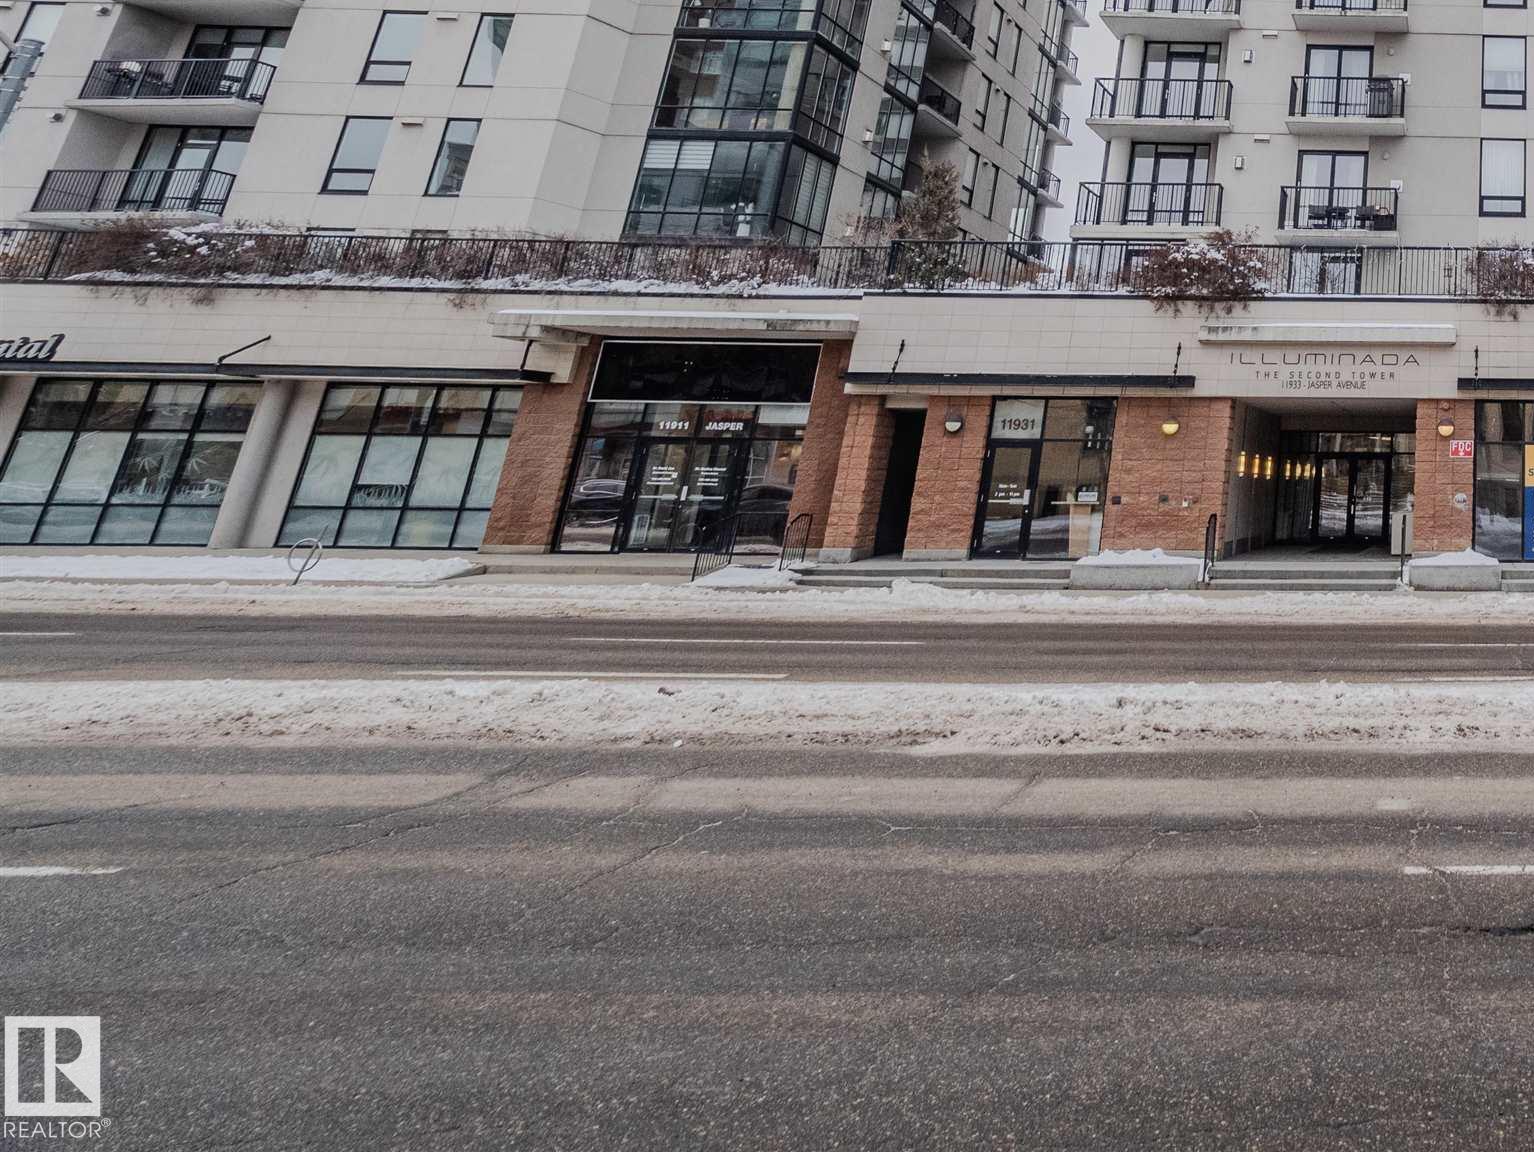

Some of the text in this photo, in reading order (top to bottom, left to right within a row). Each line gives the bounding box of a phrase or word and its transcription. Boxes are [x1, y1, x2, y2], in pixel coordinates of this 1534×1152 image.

[1255, 371, 1395, 380] THE SECOND TOWER
[1307, 380, 1333, 390] JASPER
[1336, 380, 1367, 390] AVENUE
[659, 420, 744, 431] 11911 JASPER
[1000, 418, 1036, 431] 11931
[1452, 441, 1472, 452] FDC
